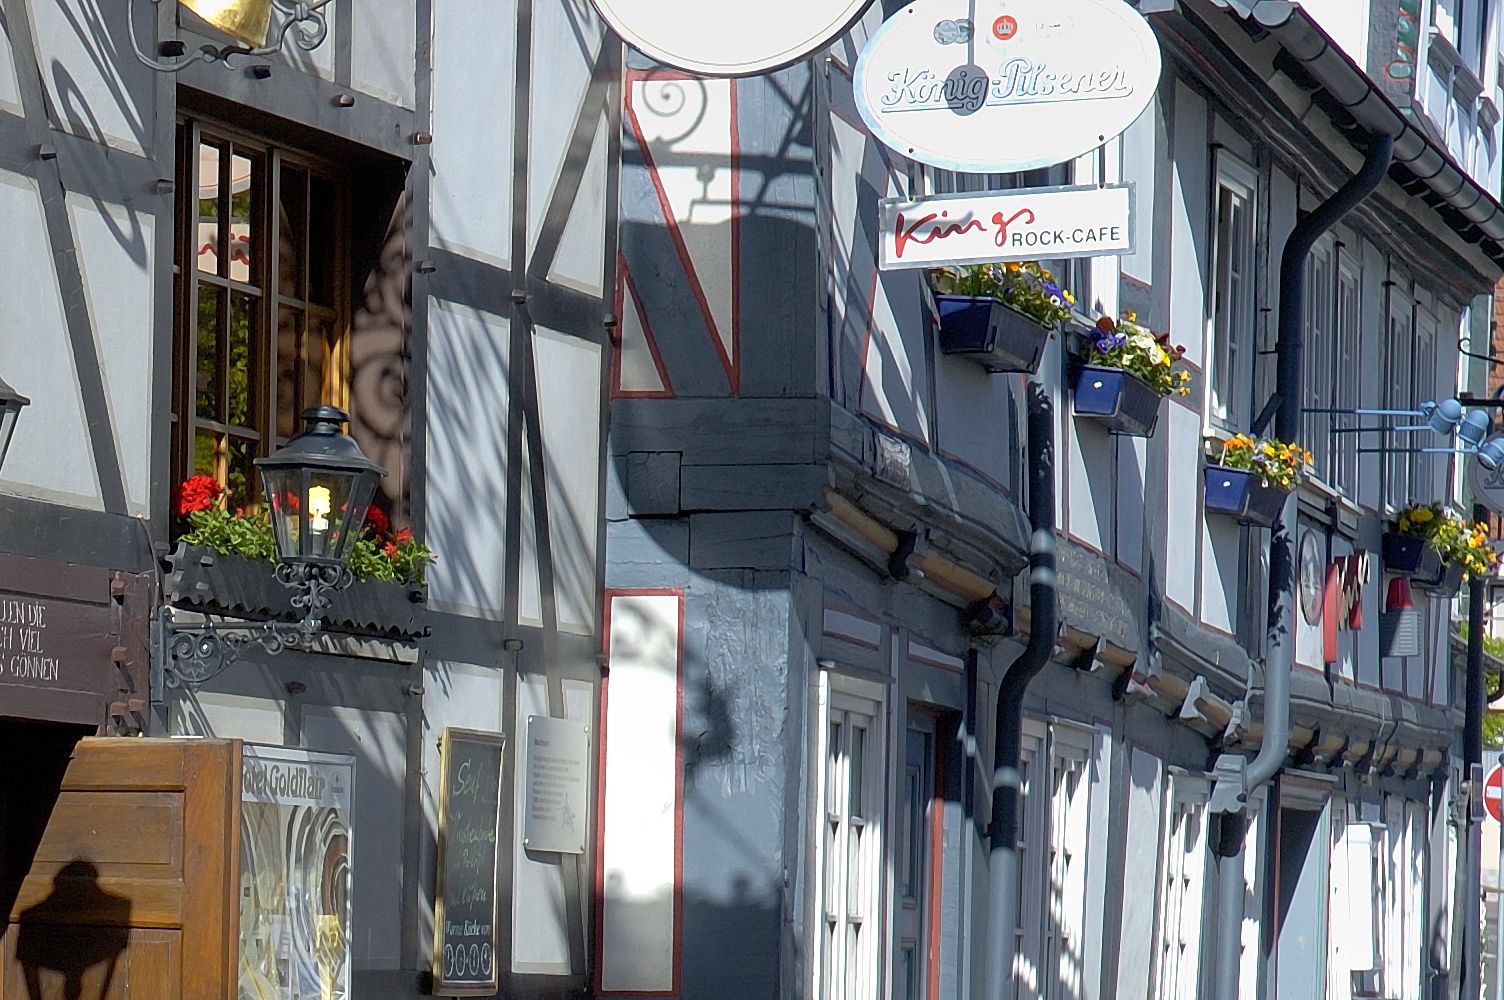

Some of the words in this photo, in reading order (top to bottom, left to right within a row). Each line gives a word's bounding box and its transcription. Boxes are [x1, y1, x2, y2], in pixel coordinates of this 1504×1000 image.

[1012, 227, 1121, 247] ROCK-CAFE
[28, 601, 46, 628] DIE
[19, 626, 43, 653] VIEL
[10, 652, 59, 680] GÖNNEN
[244, 763, 268, 796] otel
[269, 764, 325, 800] Goldflair
